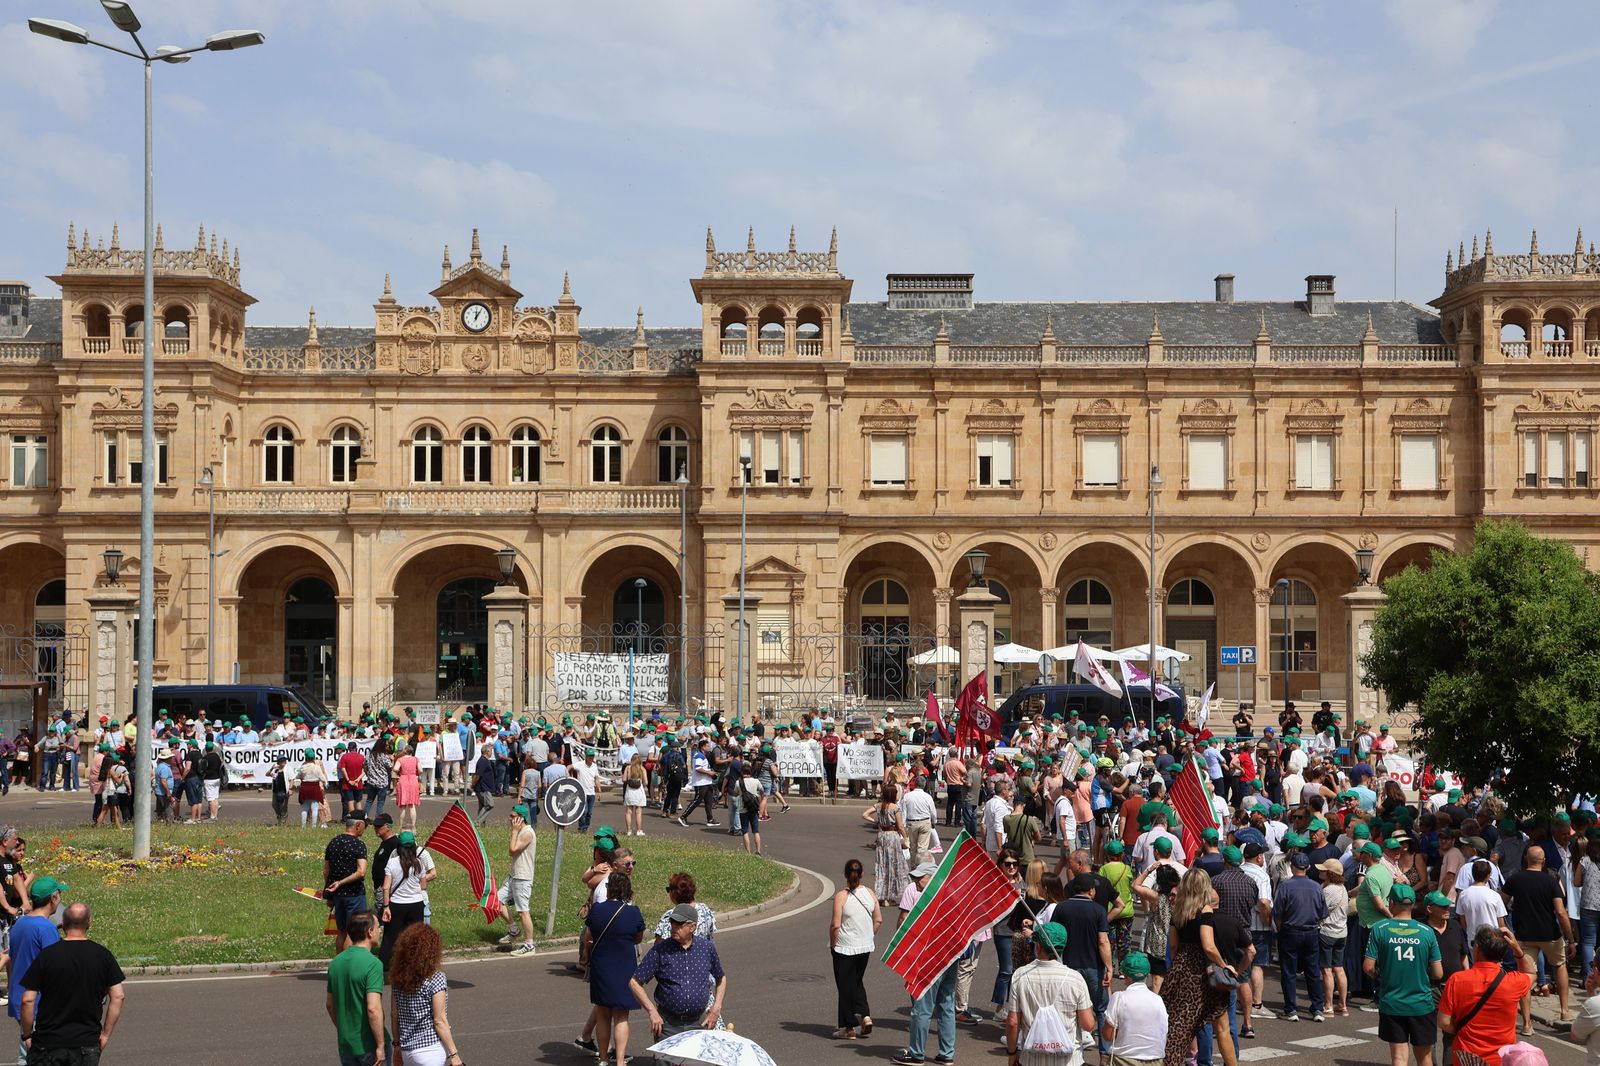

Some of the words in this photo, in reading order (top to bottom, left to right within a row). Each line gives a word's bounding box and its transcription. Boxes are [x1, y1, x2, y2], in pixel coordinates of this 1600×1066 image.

[586, 652, 612, 663] AVE
[634, 654, 666, 663] PARA
[1242, 648, 1253, 662] P
[557, 662, 569, 673] LO
[573, 662, 618, 674] PARAMOS
[558, 673, 621, 688] SANABRIA
[626, 675, 639, 687] EN
[640, 675, 669, 688] LUCHA
[568, 688, 588, 701] POR
[594, 689, 612, 702] SUS
[619, 689, 669, 703] DERECHO
[235, 750, 260, 764] CON
[263, 747, 323, 763] SERVICS
[783, 752, 807, 760] EXIGEN
[842, 747, 854, 757] NO
[856, 749, 876, 758] SOMOS
[848, 757, 872, 766] TIERRA
[779, 761, 822, 775] PARADA
[839, 766, 847, 774] DE
[1388, 937, 1421, 945] ALONSO
[1394, 945, 1416, 962] 14
